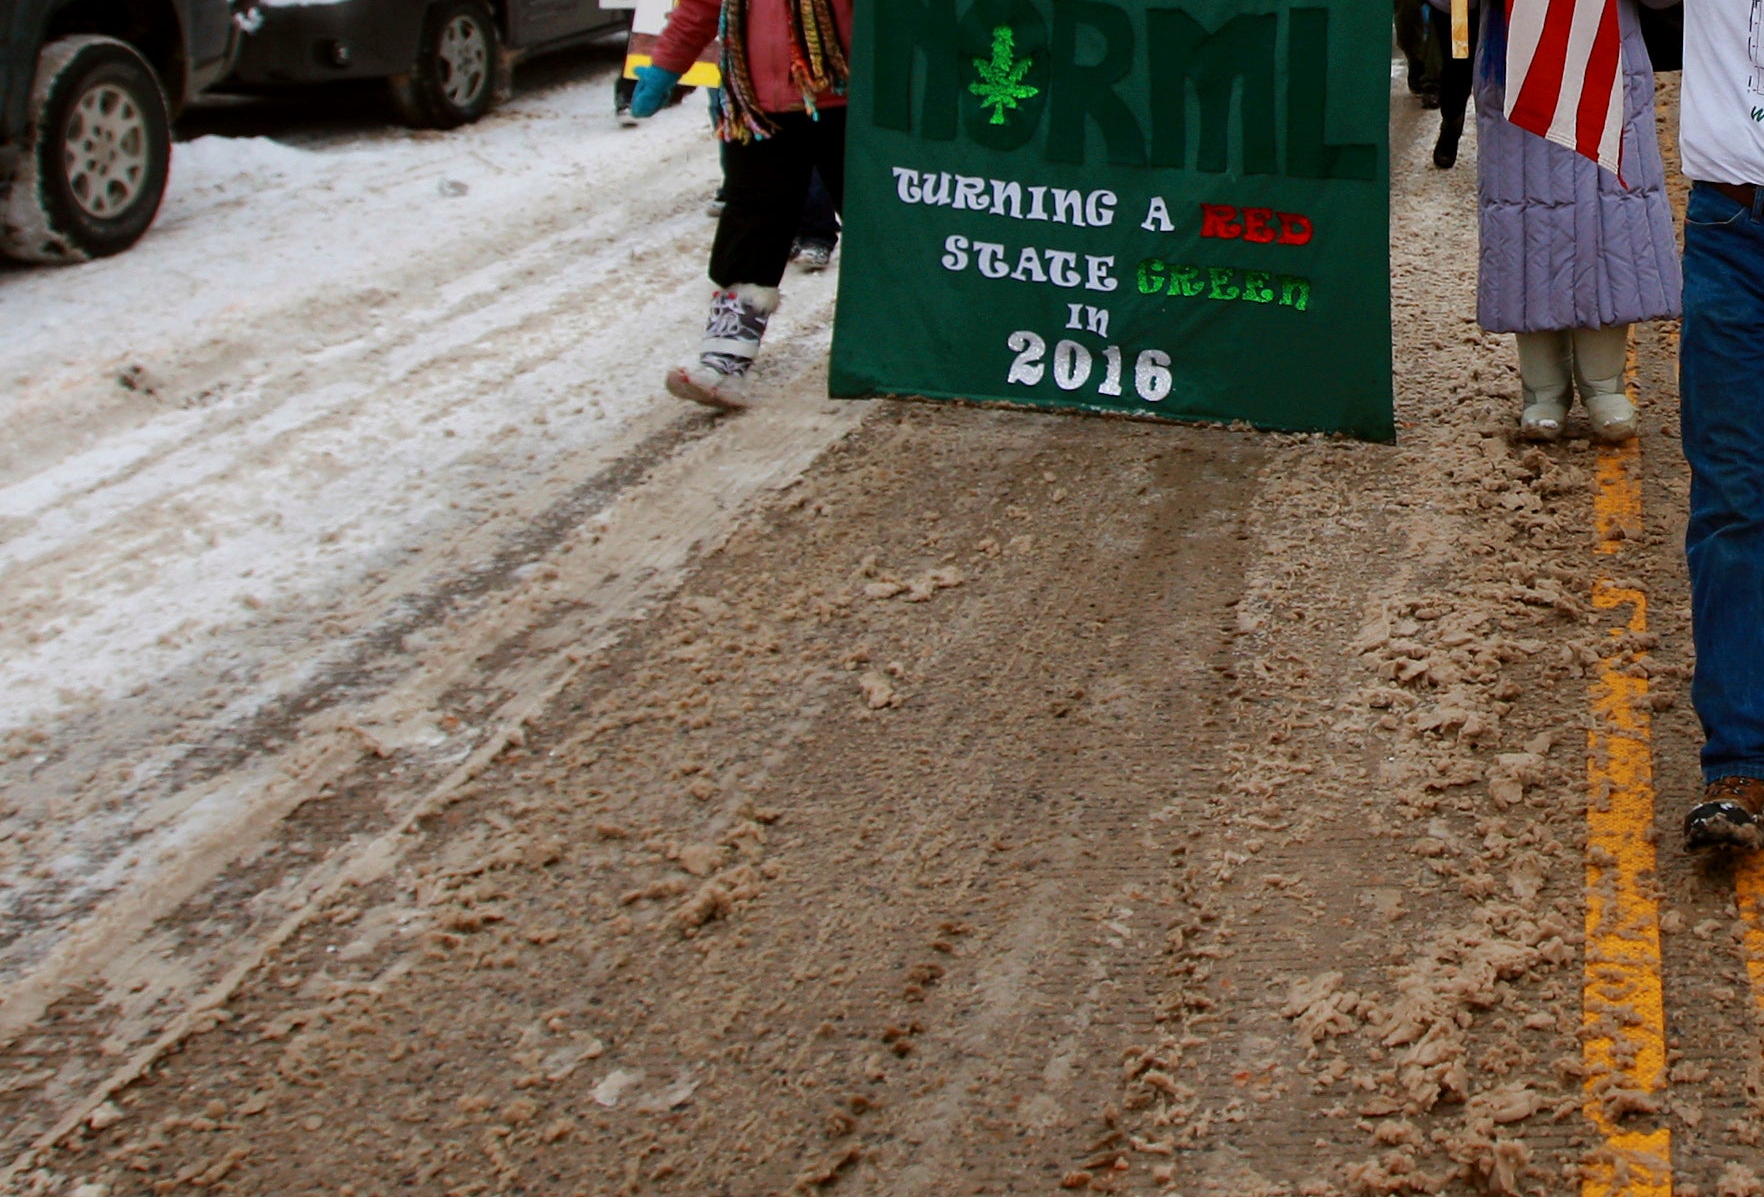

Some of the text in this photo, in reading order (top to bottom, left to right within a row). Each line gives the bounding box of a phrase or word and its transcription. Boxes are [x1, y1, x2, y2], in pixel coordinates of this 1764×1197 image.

[892, 166, 1314, 246] TURNING A RED
[941, 235, 1312, 312] STATE GREEN
[1066, 302, 1109, 339] IN
[1006, 330, 1173, 402] 2016
